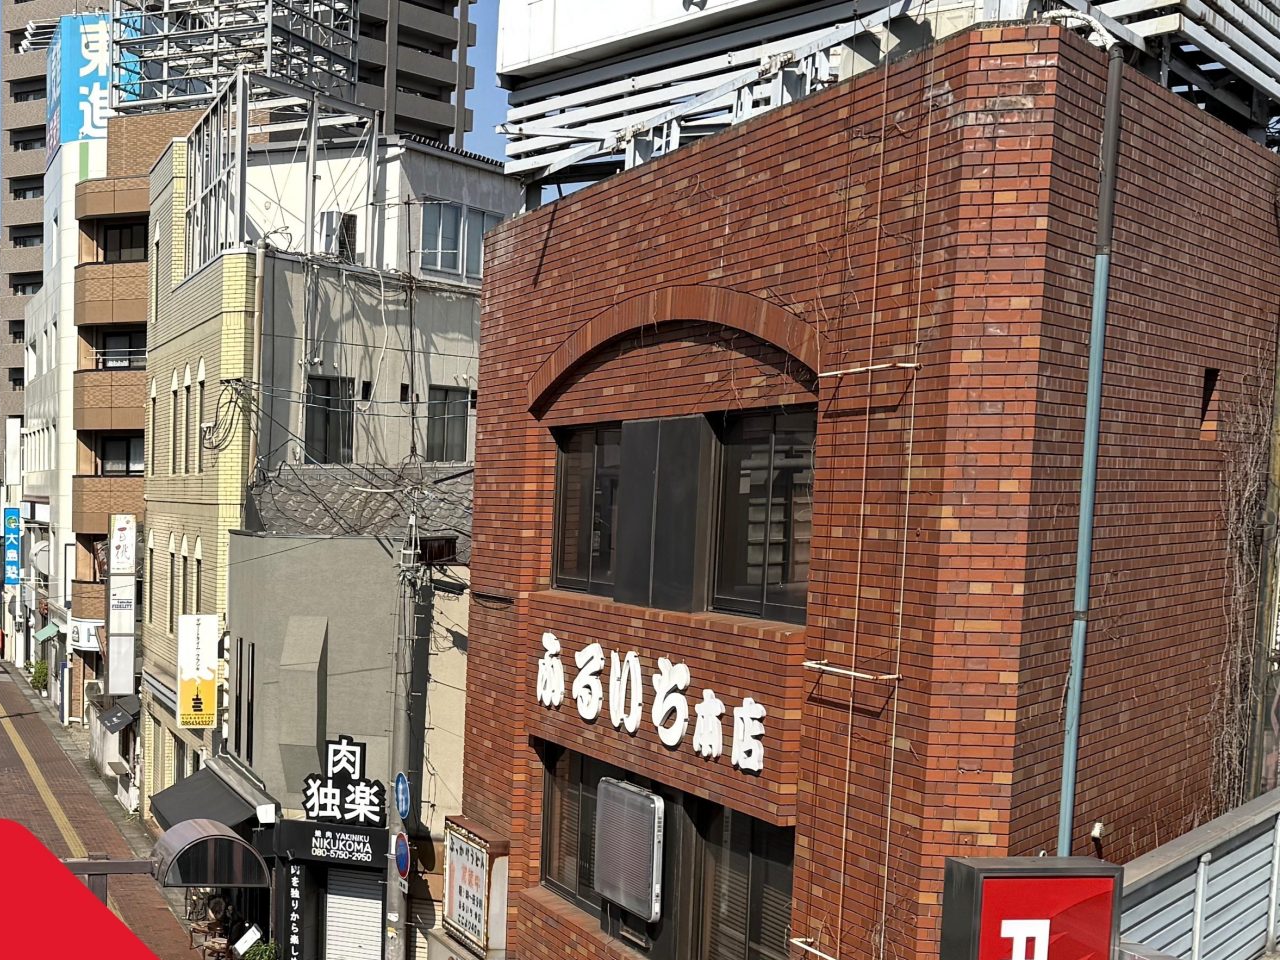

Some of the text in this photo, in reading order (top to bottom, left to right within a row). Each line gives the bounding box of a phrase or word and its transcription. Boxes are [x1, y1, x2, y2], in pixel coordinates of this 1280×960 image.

[327, 739, 360, 780] 肉
[306, 778, 381, 822] 独楽
[312, 837, 372, 853] NIKUKOMA
[335, 832, 370, 843] YAKINIKU
[311, 848, 372, 862] 080-5750-2950
